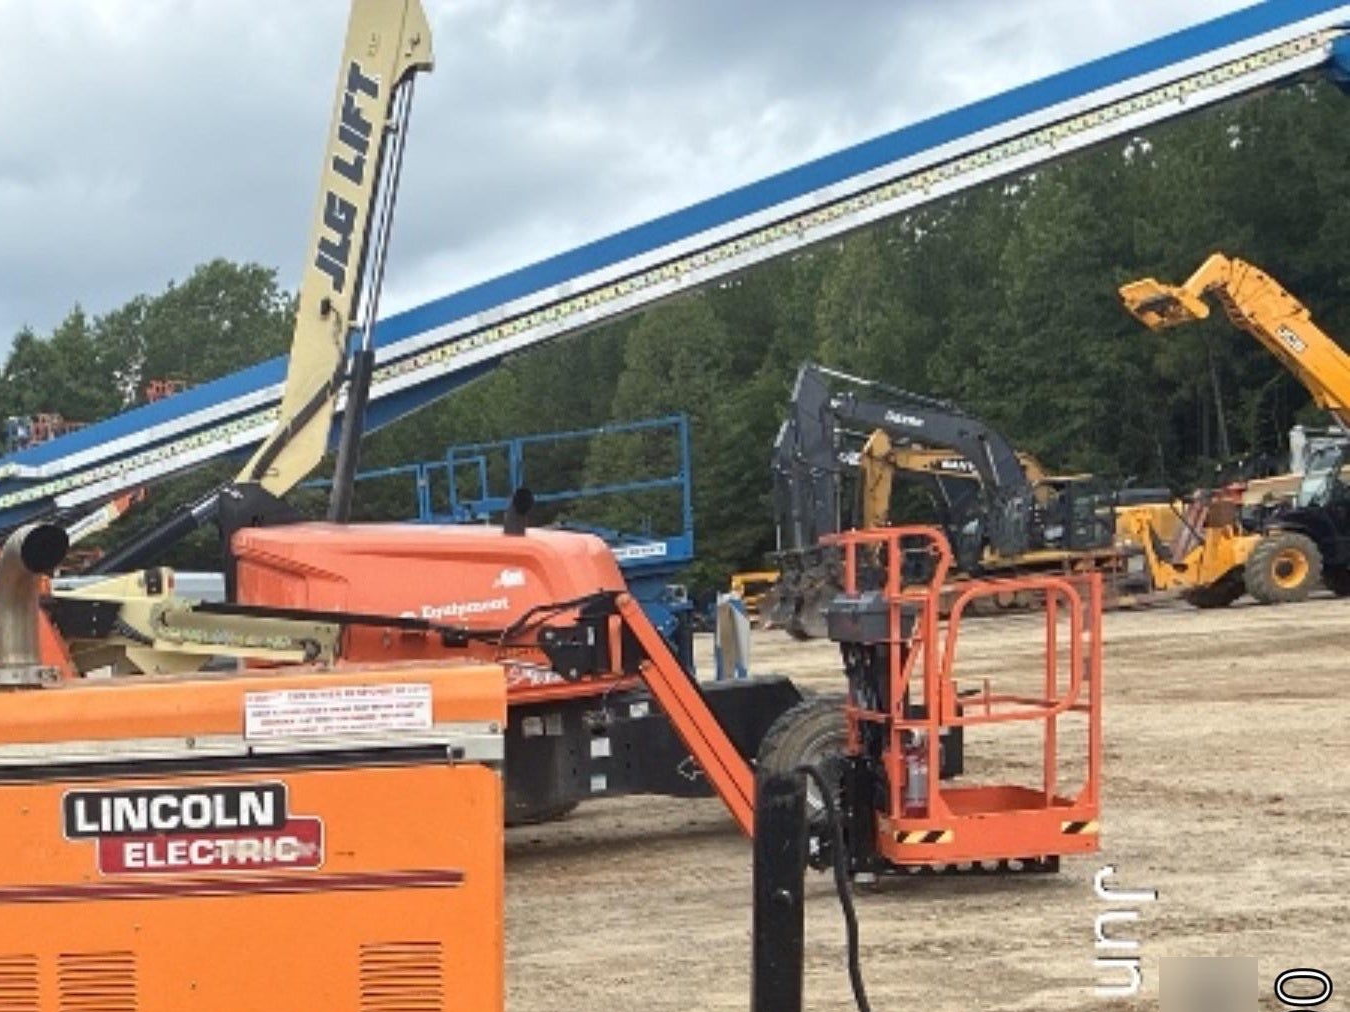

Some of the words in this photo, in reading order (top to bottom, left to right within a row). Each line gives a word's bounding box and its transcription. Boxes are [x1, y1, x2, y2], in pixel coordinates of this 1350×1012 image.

[332, 60, 379, 187] LIFT
[315, 191, 357, 293] JLG
[74, 791, 274, 833] LINCOLN
[124, 835, 300, 868] ELECTRIC
